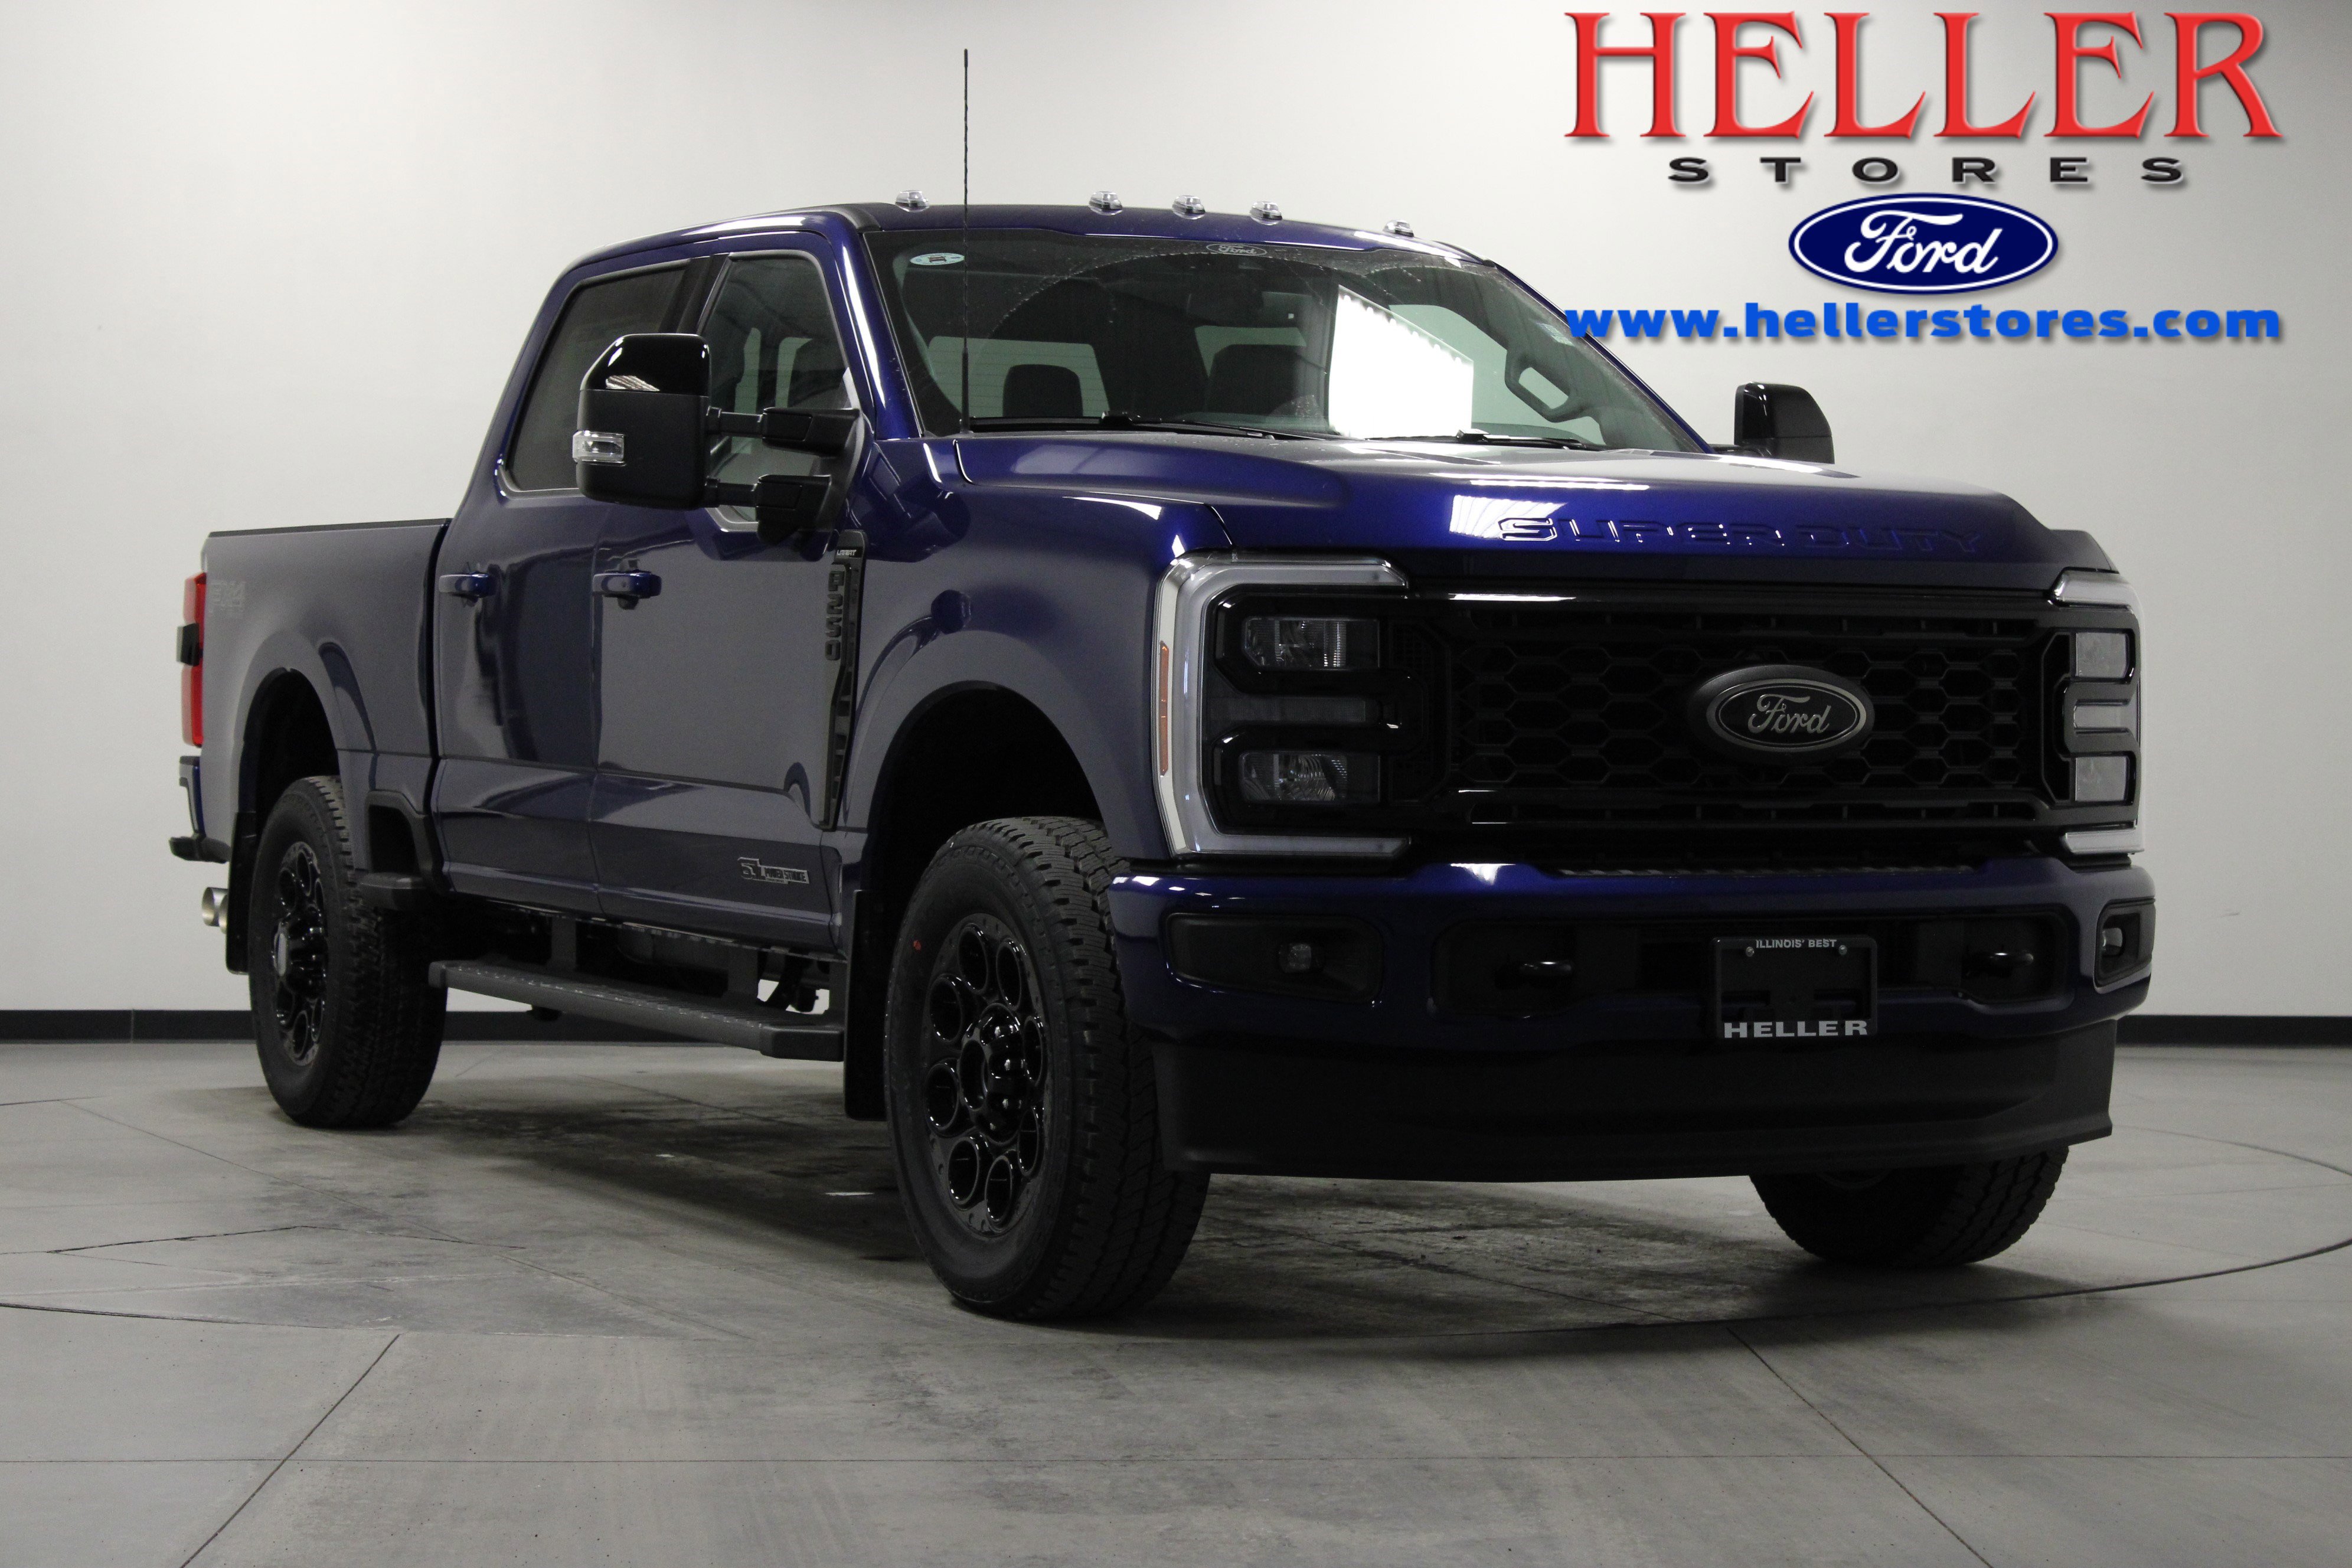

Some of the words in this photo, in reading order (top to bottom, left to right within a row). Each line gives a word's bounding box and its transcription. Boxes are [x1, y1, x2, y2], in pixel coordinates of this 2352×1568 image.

[1218, 244, 1256, 254] Ford
[1497, 517, 1785, 545] SUPER
[1795, 524, 1980, 552] DUTY
[1747, 693, 1831, 733] Ford
[1808, 939, 1837, 948] BEST
[1724, 1020, 1868, 1038] HELLER
